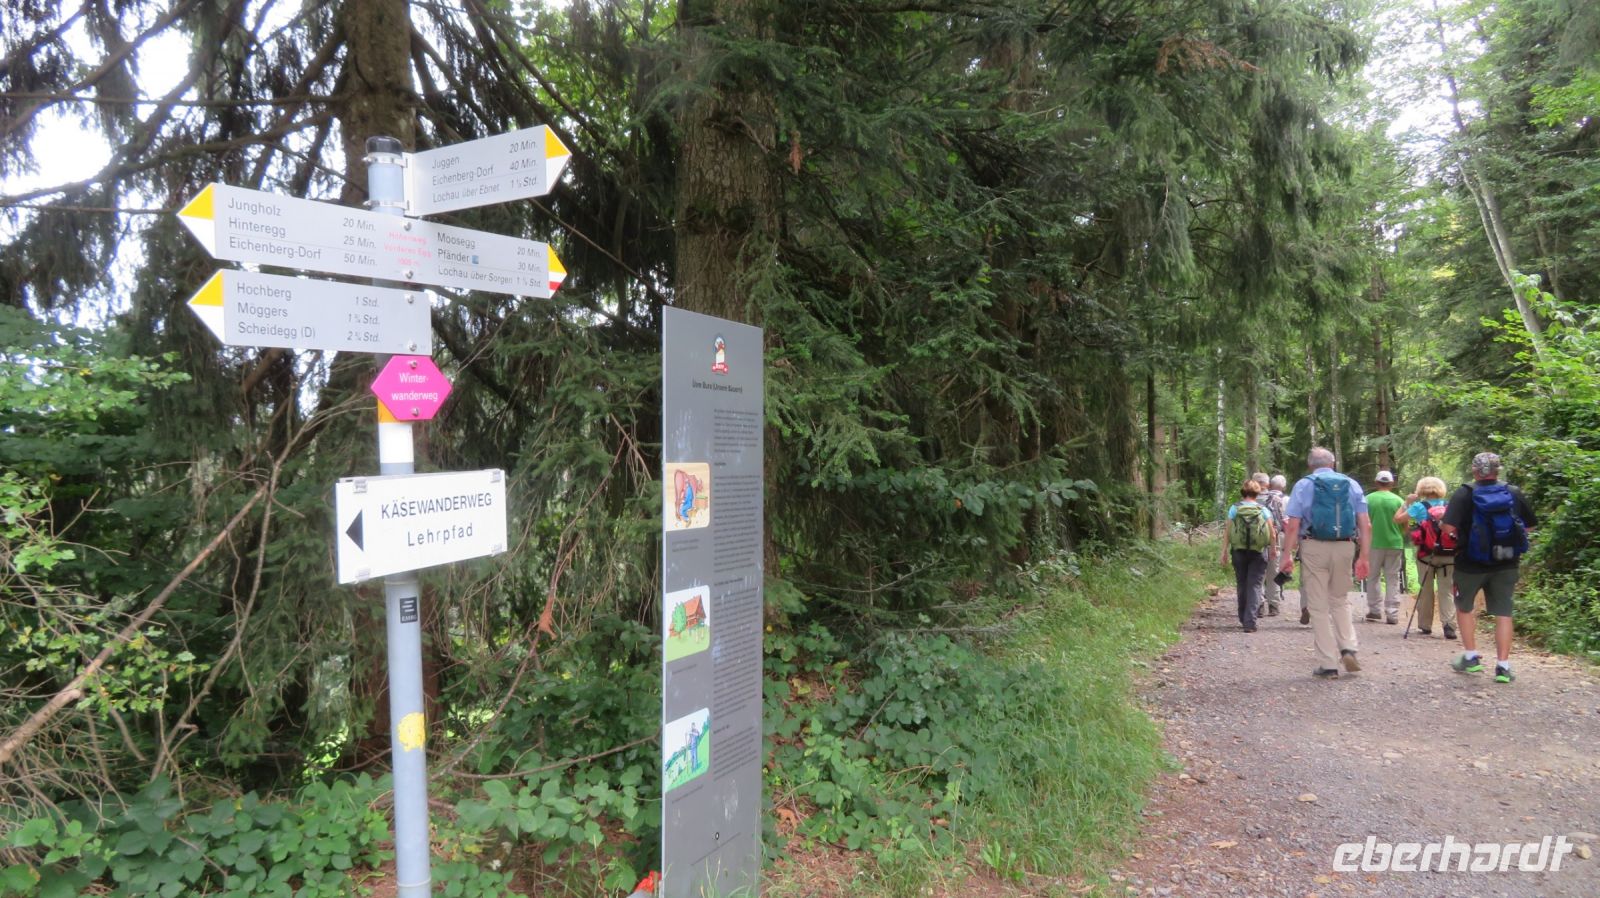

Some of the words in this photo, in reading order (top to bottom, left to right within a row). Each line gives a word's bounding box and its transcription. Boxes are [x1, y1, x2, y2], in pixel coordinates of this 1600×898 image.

[432, 156, 460, 170] Juggen
[509, 143, 518, 153] 20
[521, 140, 538, 151] Min.
[432, 166, 494, 186] Eichenberg-Dorf
[509, 160, 519, 171] 40
[521, 158, 538, 168] Min.
[433, 189, 460, 203] Lochau
[462, 186, 478, 200] über
[479, 183, 500, 196] Ebnet
[523, 176, 539, 187] Std.
[228, 198, 281, 217] Jungholz
[342, 217, 355, 229] 20
[357, 220, 376, 232] Min.
[229, 217, 287, 237] Hinteregg
[343, 235, 355, 246] 25
[357, 237, 377, 249] Min.
[437, 232, 476, 249] Moosegg
[229, 236, 322, 259] Eichenberg-Dorf
[344, 253, 356, 264] 50
[358, 255, 378, 267] Min.
[437, 249, 470, 263] Pfänder
[517, 261, 526, 271] 30
[438, 266, 468, 279] Lochau
[470, 269, 487, 281] über
[488, 271, 513, 285] Sorgen
[237, 283, 292, 301] Hochberg
[355, 296, 359, 305] 1
[362, 296, 380, 307] Std.
[237, 303, 288, 318] Möggers
[363, 314, 380, 325] Std.
[238, 322, 297, 339] Scheidegg
[300, 326, 316, 339] (D)
[363, 331, 380, 342] Std.
[399, 373, 429, 384] Winter-
[391, 391, 439, 403] wanderweg
[381, 492, 492, 520] KÄSEWANDERWEG
[407, 523, 473, 547] Lehrpfad
